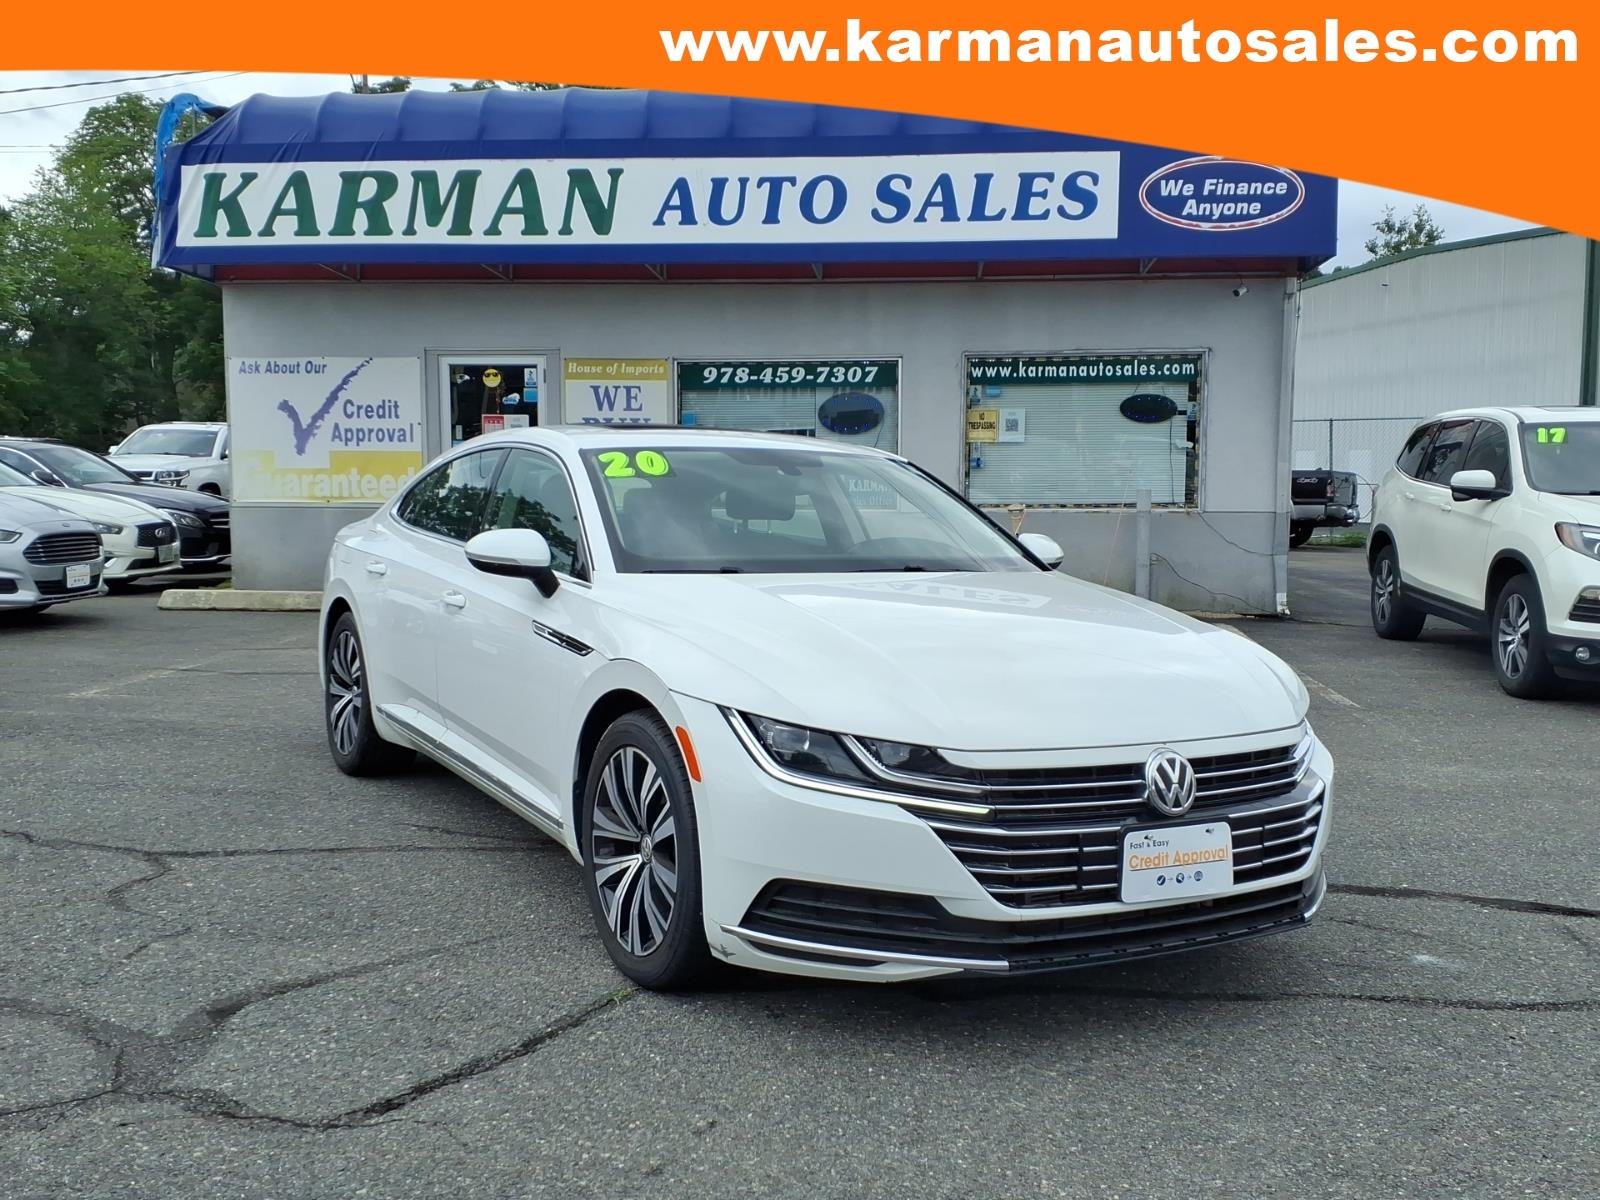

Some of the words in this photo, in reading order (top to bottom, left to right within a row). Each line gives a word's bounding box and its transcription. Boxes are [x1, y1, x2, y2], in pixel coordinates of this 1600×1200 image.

[1160, 180, 1195, 197] We
[1202, 178, 1288, 196] Finance
[193, 168, 624, 238] KARMAN
[652, 174, 848, 227] AUTO
[870, 170, 1100, 224] SALES
[1182, 199, 1262, 220] Anyone
[238, 361, 261, 374] Ask
[264, 360, 301, 374] About
[304, 360, 328, 374] Our
[568, 362, 600, 374] House
[606, 362, 618, 375] of
[621, 363, 665, 376] Imports
[703, 366, 879, 384] 978-459-7307
[971, 359, 1195, 378] www.karmanautosales.com
[589, 385, 643, 412] WE
[342, 399, 400, 420] Credit
[331, 422, 414, 447] Approval
[968, 421, 996, 430] TRESPASSING
[1537, 427, 1566, 443] 17
[598, 450, 669, 477] 20
[1129, 840, 1145, 850] Fast
[1152, 839, 1170, 849] Easy
[1128, 851, 1169, 870] Credit
[1172, 843, 1229, 866] Approval
